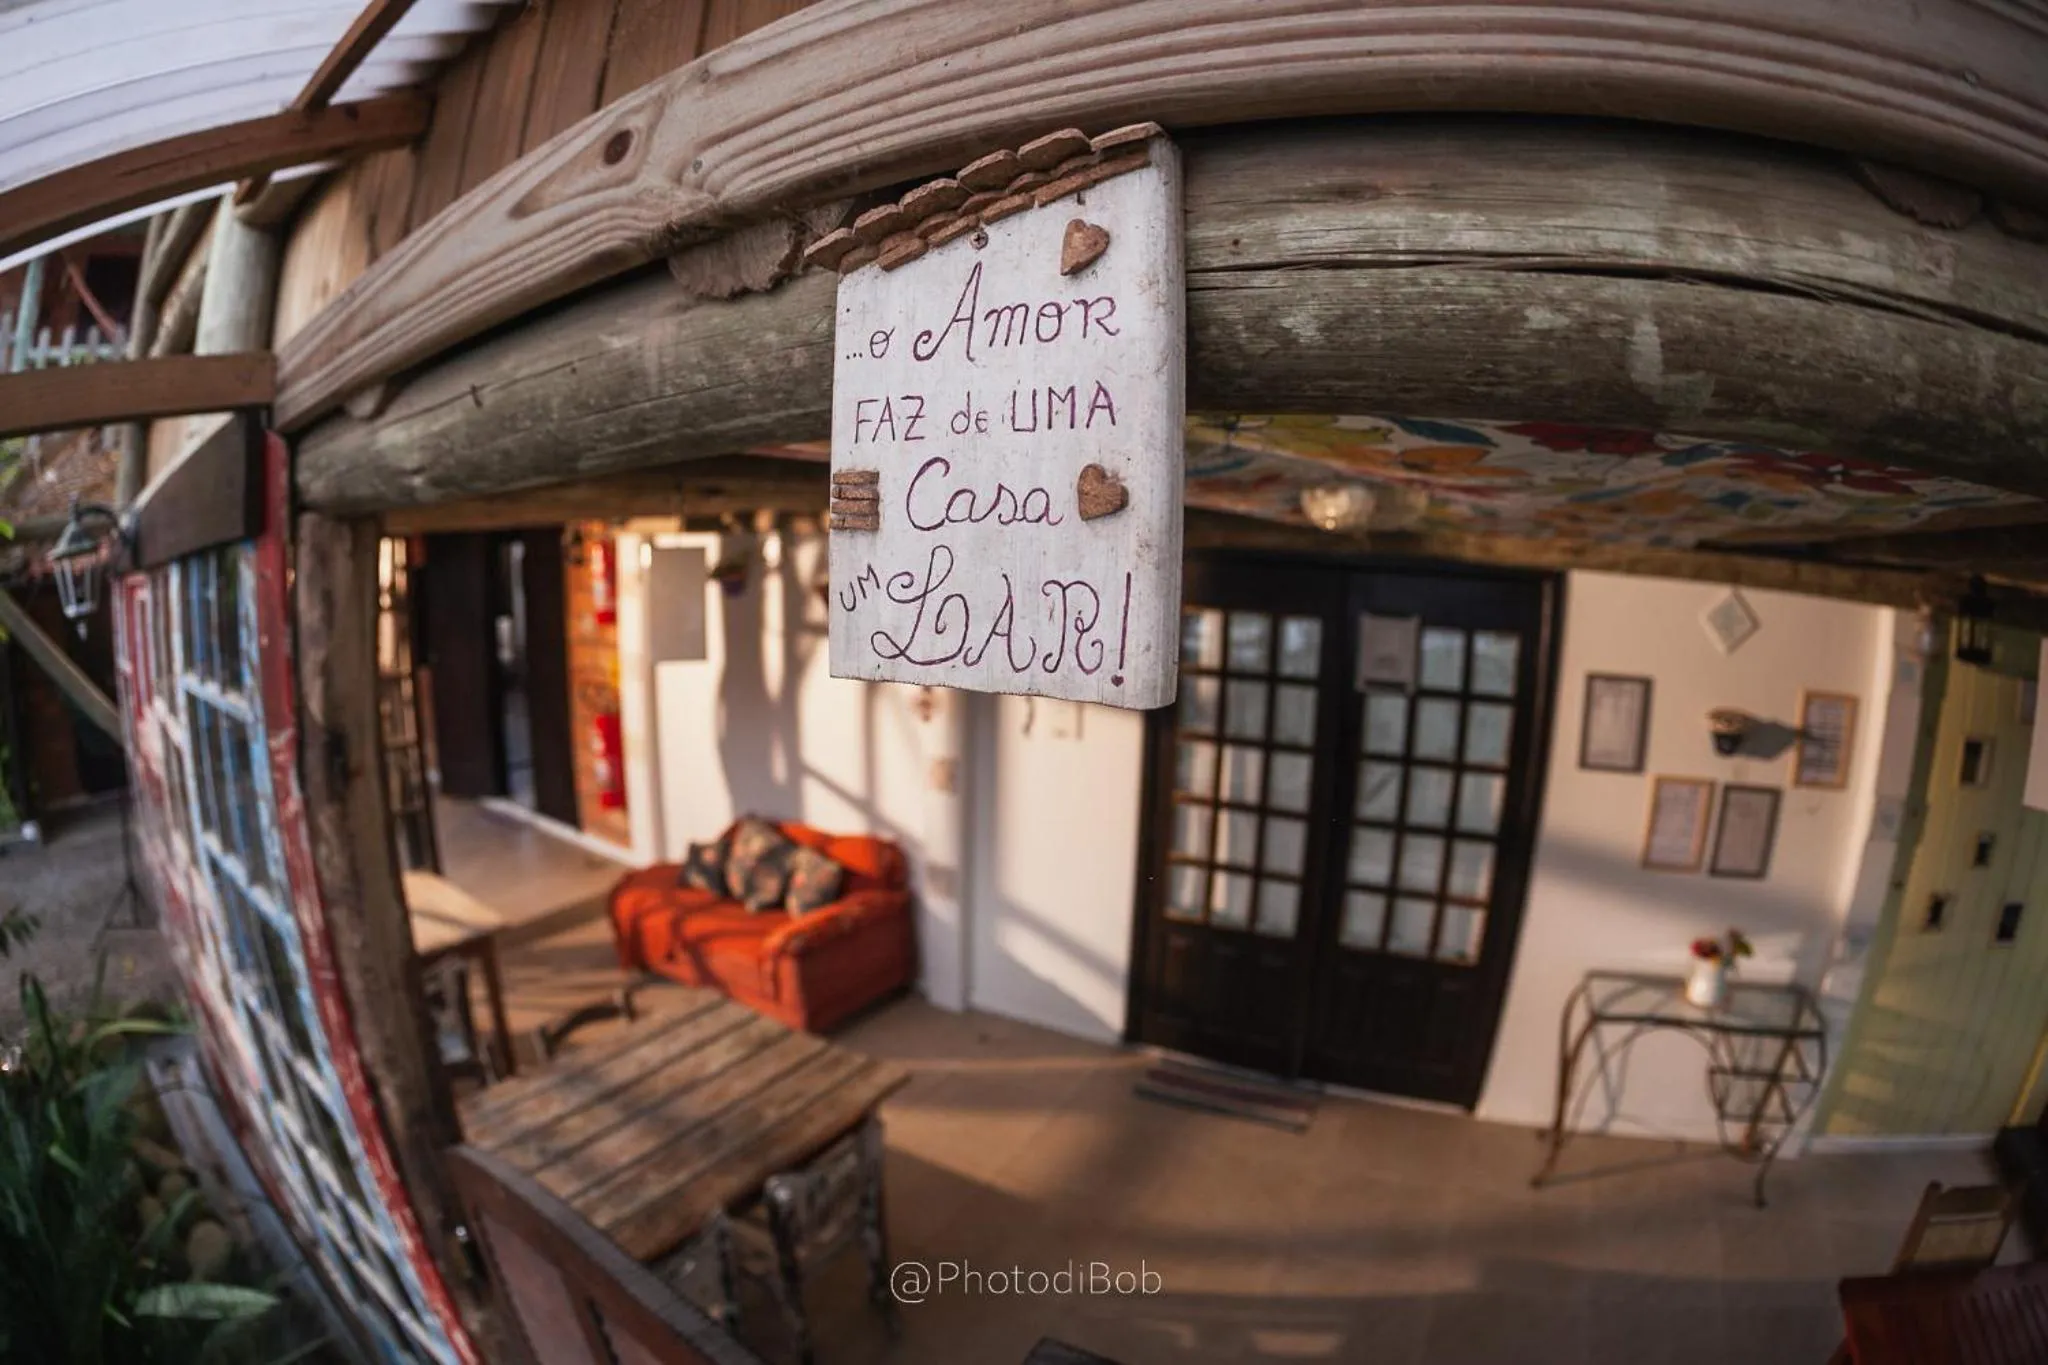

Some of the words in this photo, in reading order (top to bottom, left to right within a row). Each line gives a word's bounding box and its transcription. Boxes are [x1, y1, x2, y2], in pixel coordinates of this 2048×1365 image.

[854, 394, 926, 445] FAZ
[1011, 380, 1117, 433] UMA
[906, 457, 1064, 532] Casa
[839, 564, 881, 612] UM
